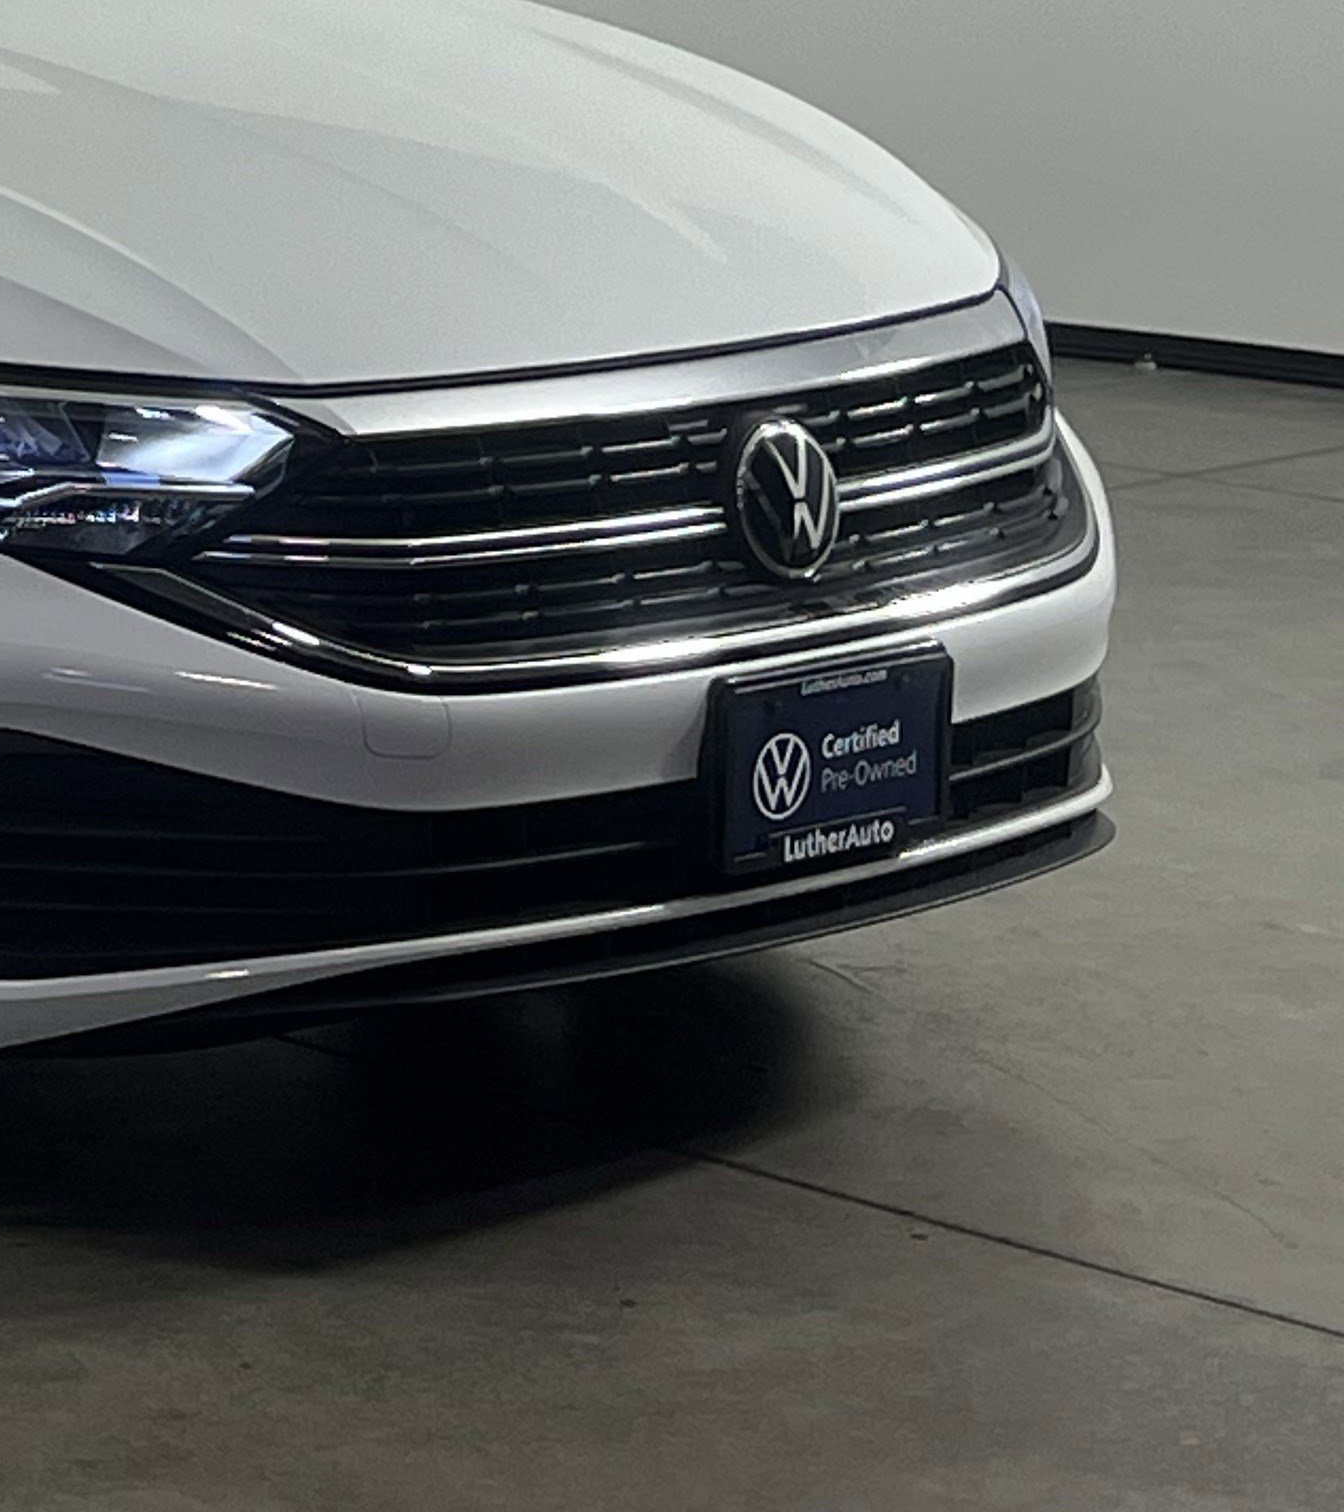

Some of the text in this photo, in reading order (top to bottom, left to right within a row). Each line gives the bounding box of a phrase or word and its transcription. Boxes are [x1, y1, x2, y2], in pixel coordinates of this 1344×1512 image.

[821, 719, 901, 758] Certified
[821, 751, 917, 793] Pre-Owned
[783, 819, 895, 863] LutherAuto
